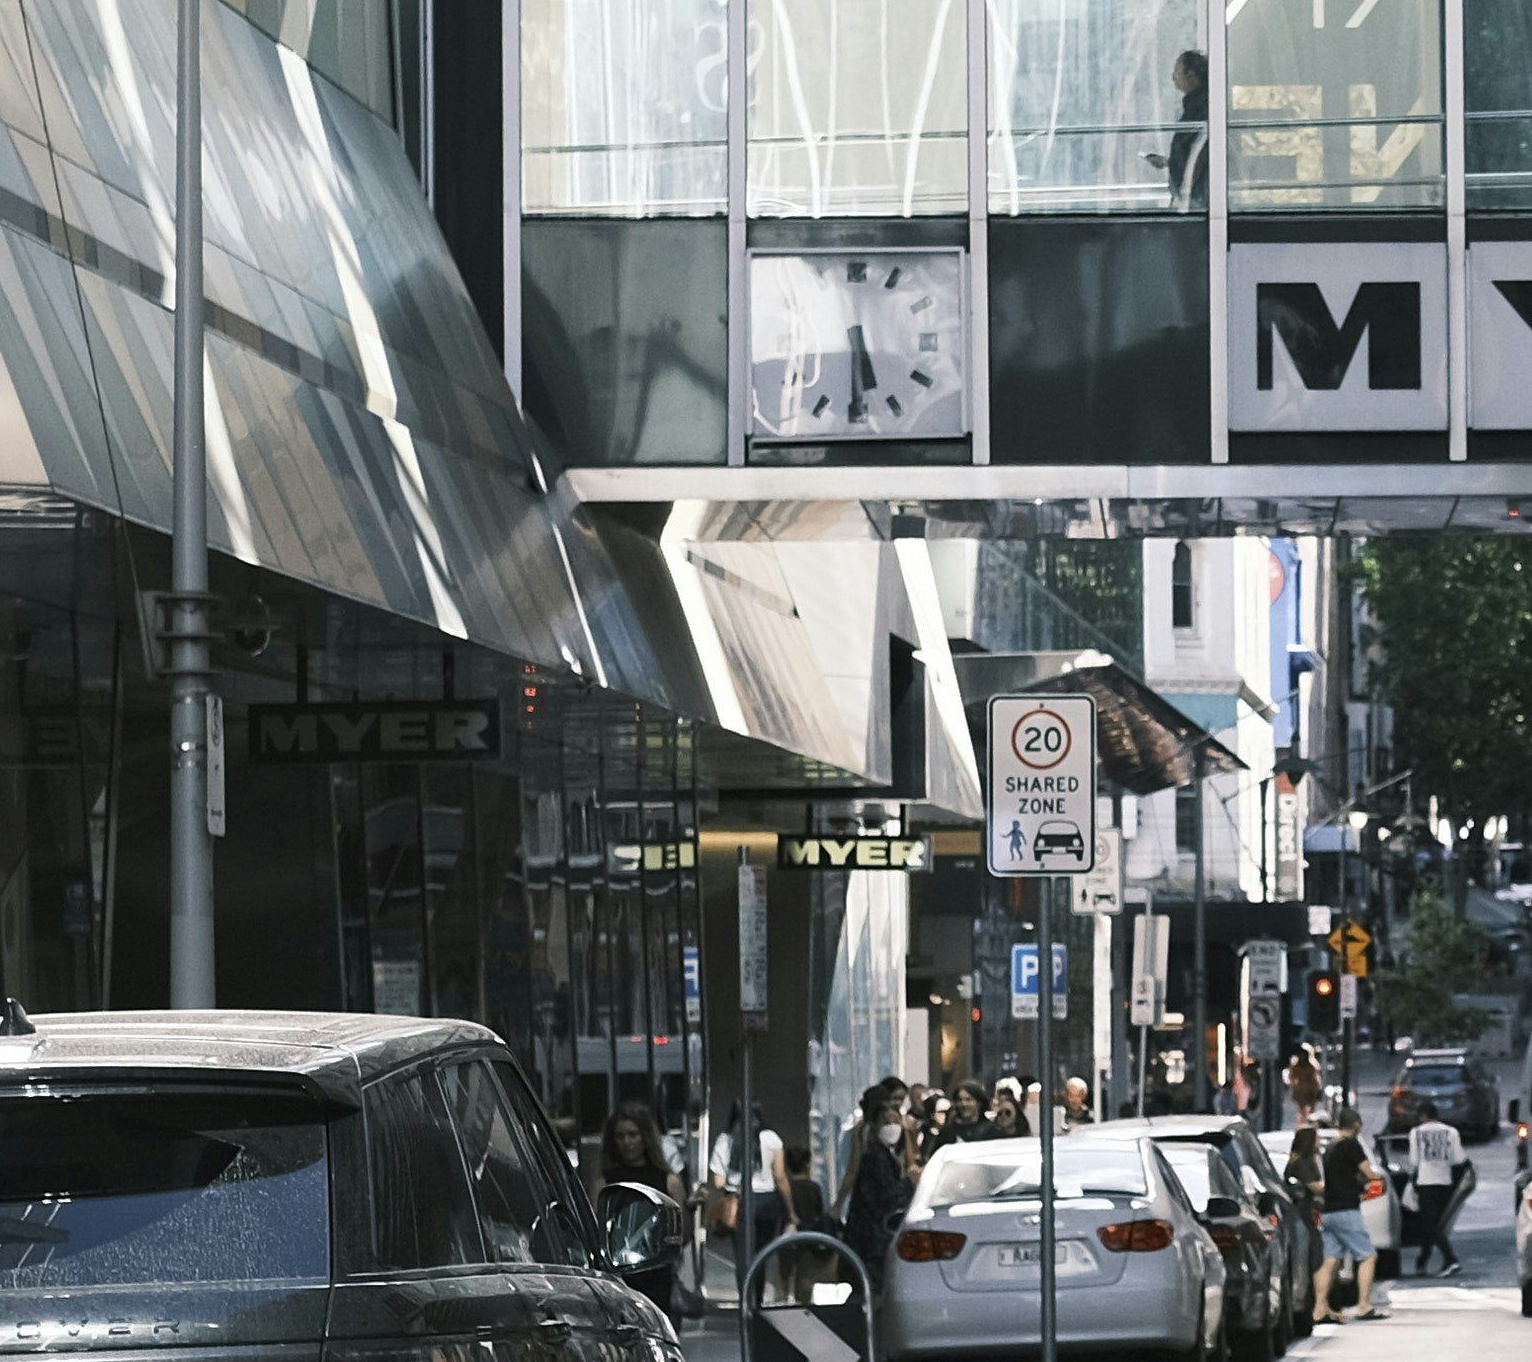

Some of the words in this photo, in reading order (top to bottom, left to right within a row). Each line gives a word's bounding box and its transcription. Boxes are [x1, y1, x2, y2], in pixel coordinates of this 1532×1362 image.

[259, 710, 489, 753] MYER
[1024, 726, 1063, 752] 20
[1005, 776, 1079, 793] SHARED
[1018, 798, 1066, 815] ZONE
[783, 839, 926, 867] MYER
